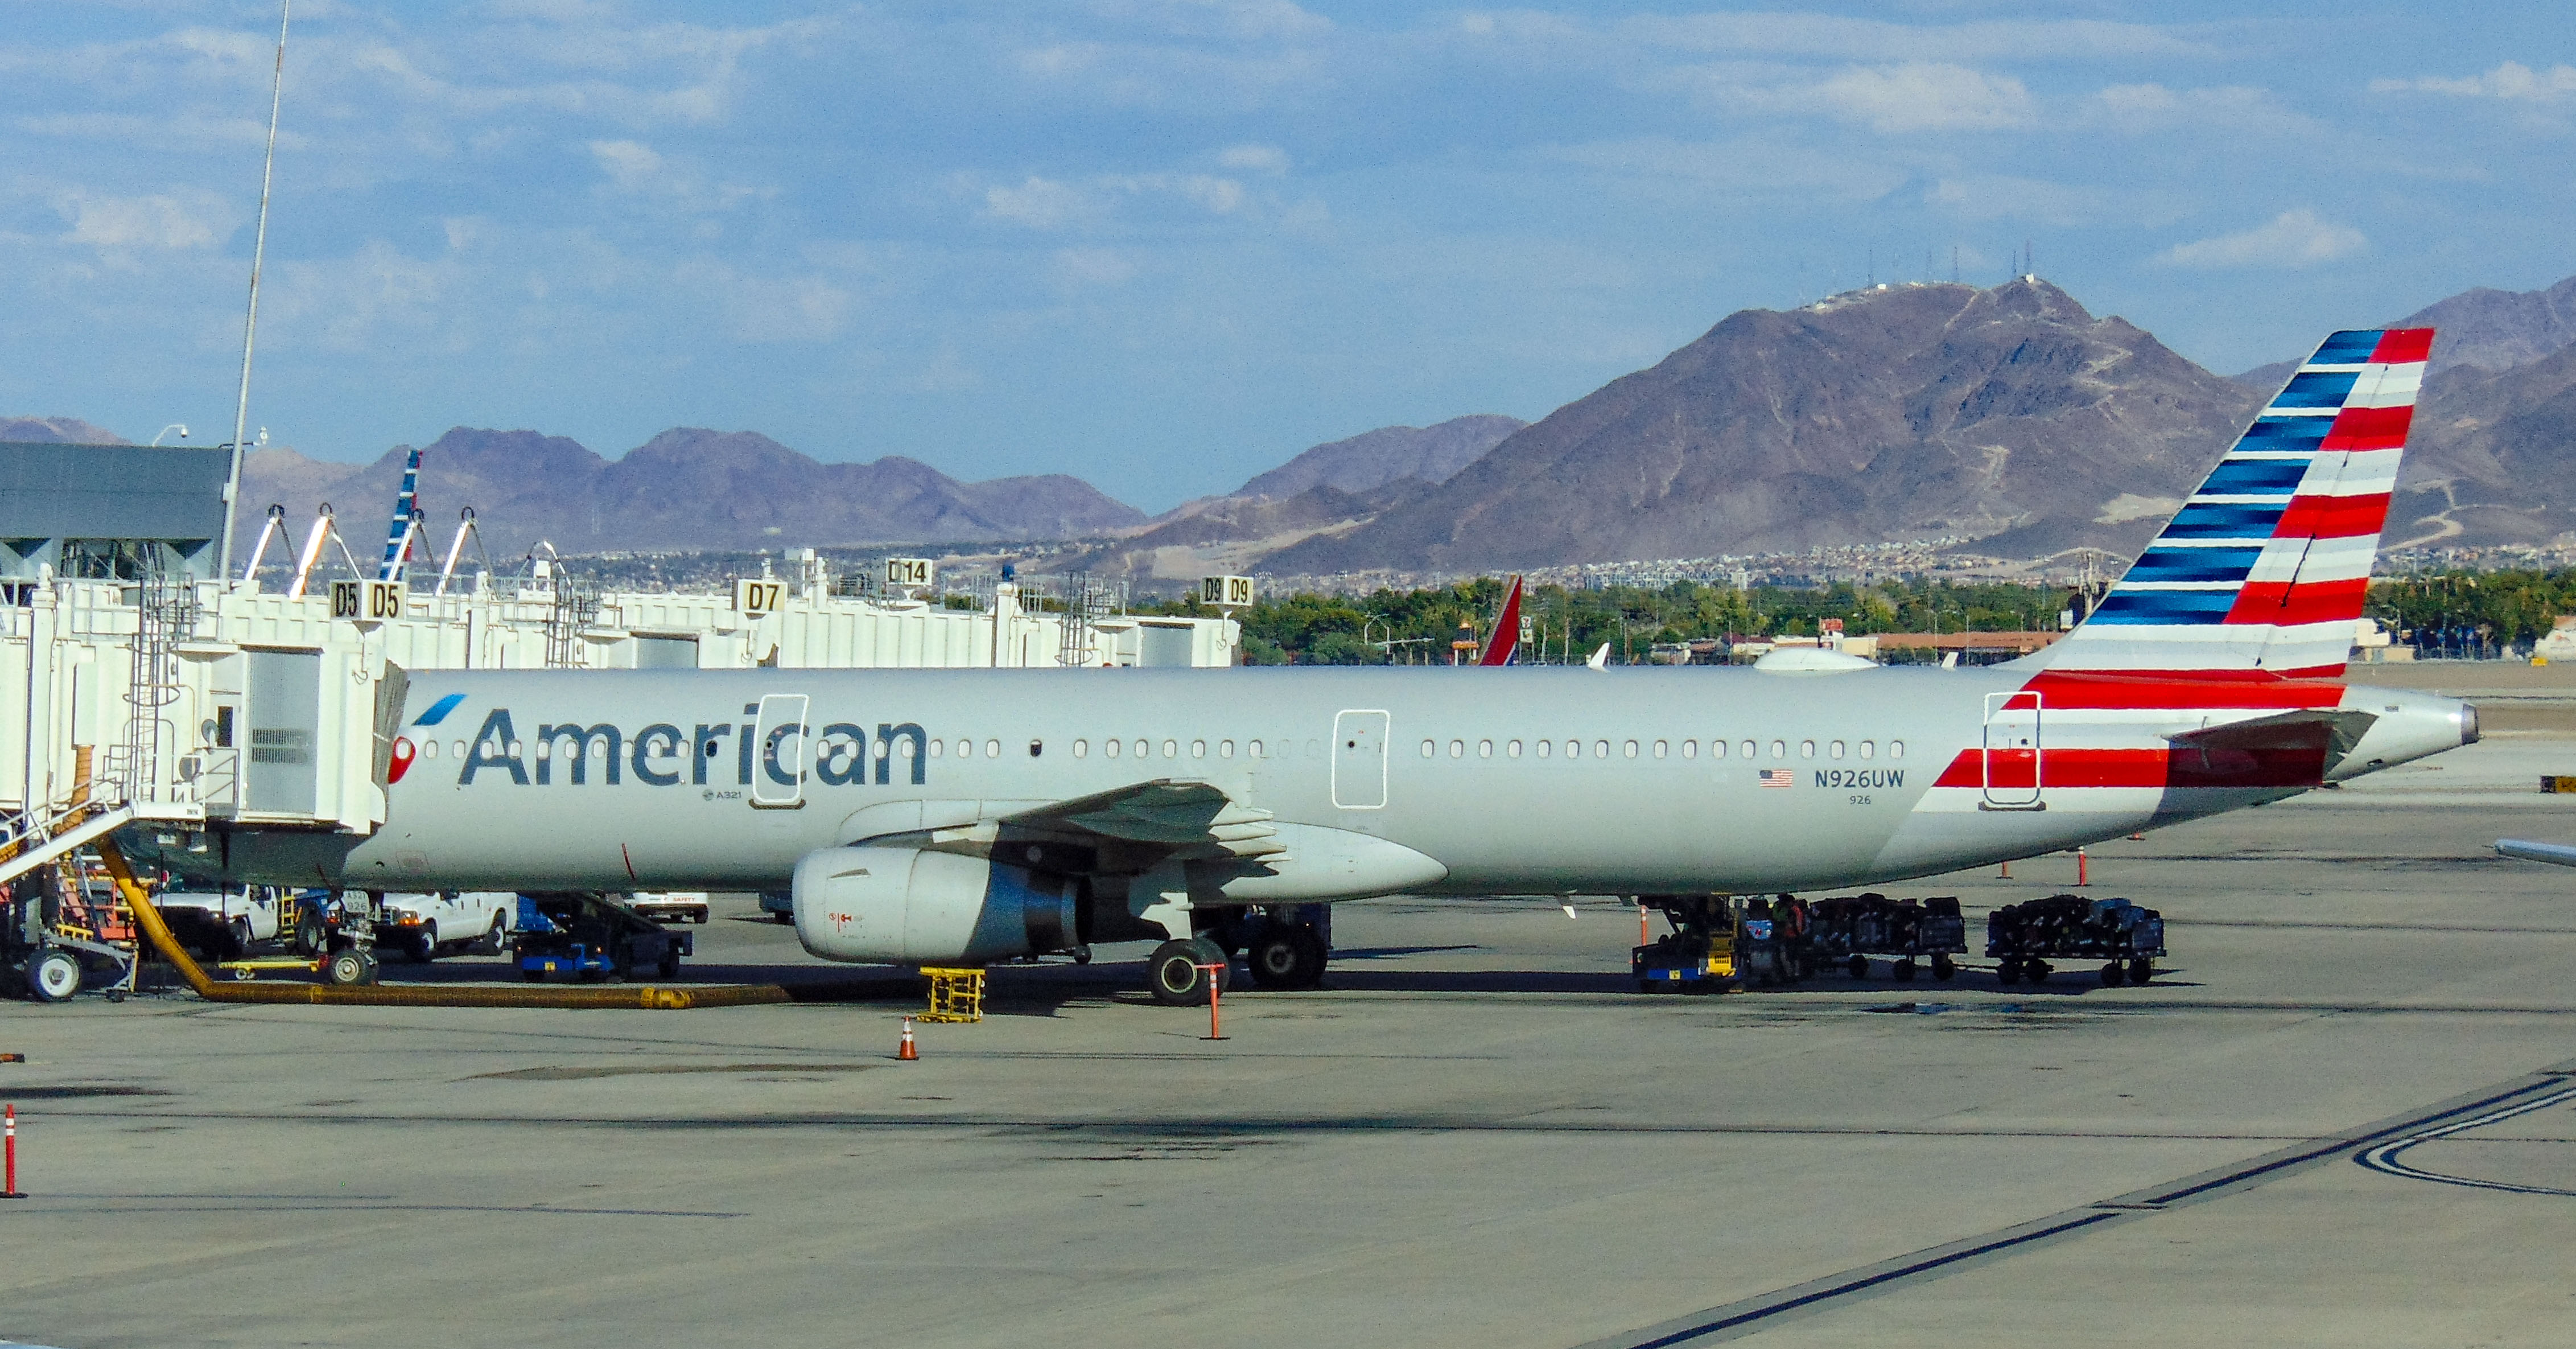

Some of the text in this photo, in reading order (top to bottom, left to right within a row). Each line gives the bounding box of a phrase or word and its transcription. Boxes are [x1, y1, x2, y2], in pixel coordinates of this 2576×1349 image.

[889, 560, 926, 582] D14
[335, 585, 358, 618] D5
[373, 585, 398, 618] D5
[748, 584, 780, 611] D7
[1205, 579, 1221, 602] D9
[1230, 578, 1248, 602] D9
[458, 705, 926, 785] American
[1815, 770, 1904, 788] N926UW
[1850, 795, 1871, 804] 926
[347, 902, 366, 911] 926
